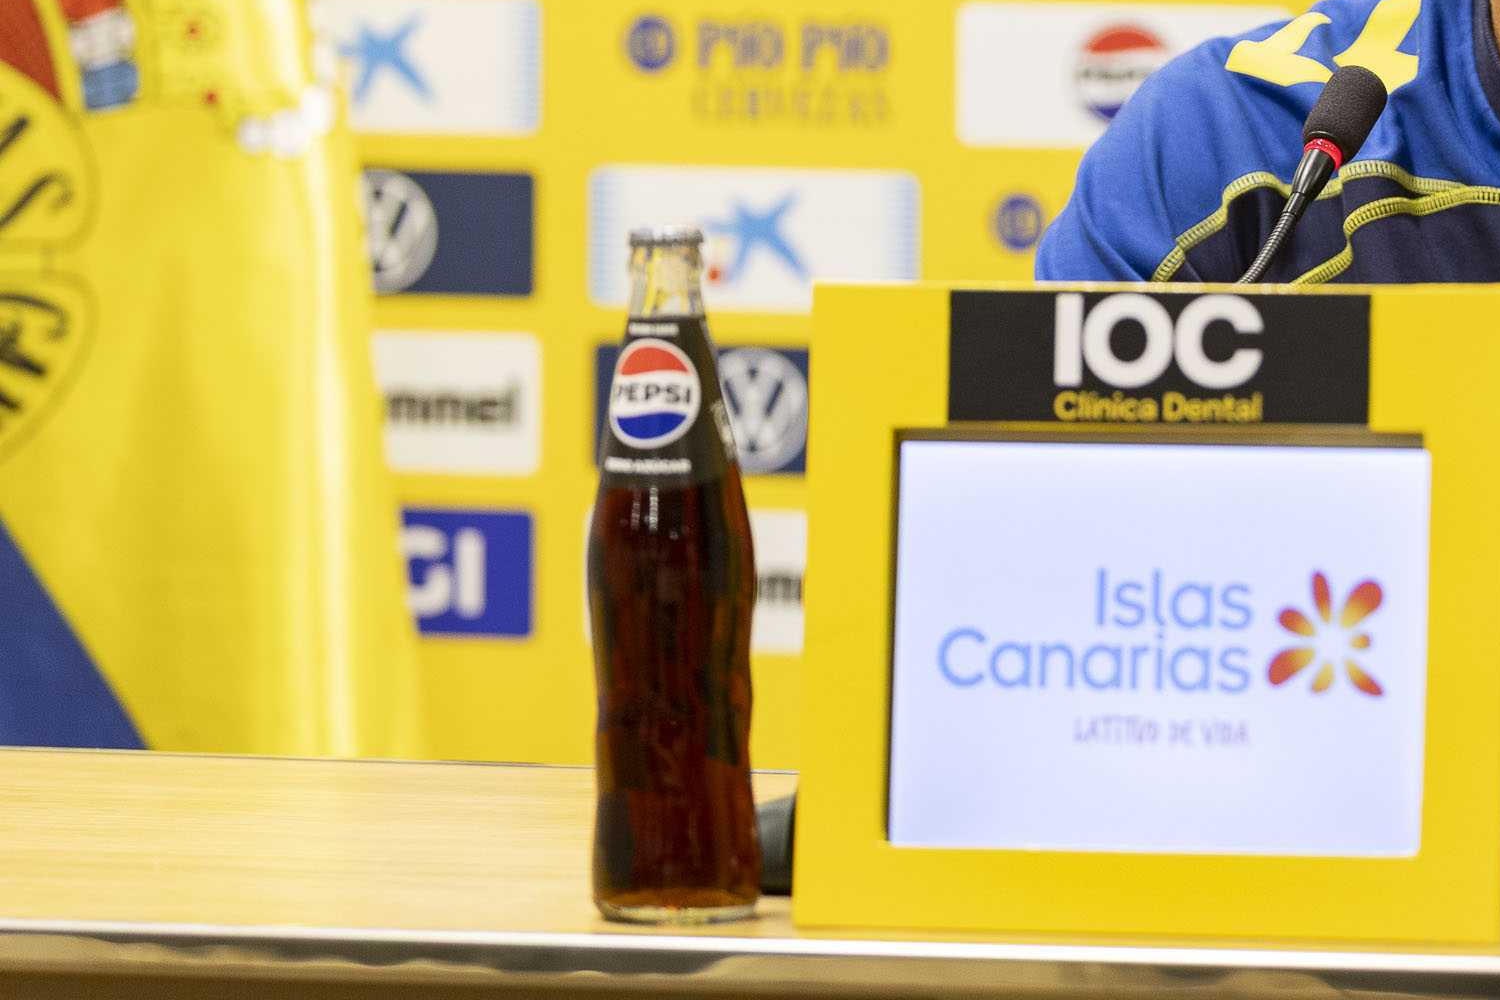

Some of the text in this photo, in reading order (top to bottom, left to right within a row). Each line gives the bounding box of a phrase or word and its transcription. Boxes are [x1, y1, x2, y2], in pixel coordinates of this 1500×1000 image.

[1053, 292, 1264, 390] IOC
[1162, 391, 1263, 422] Dental
[1096, 567, 1253, 630] Islas
[937, 627, 1252, 694] Canarias
